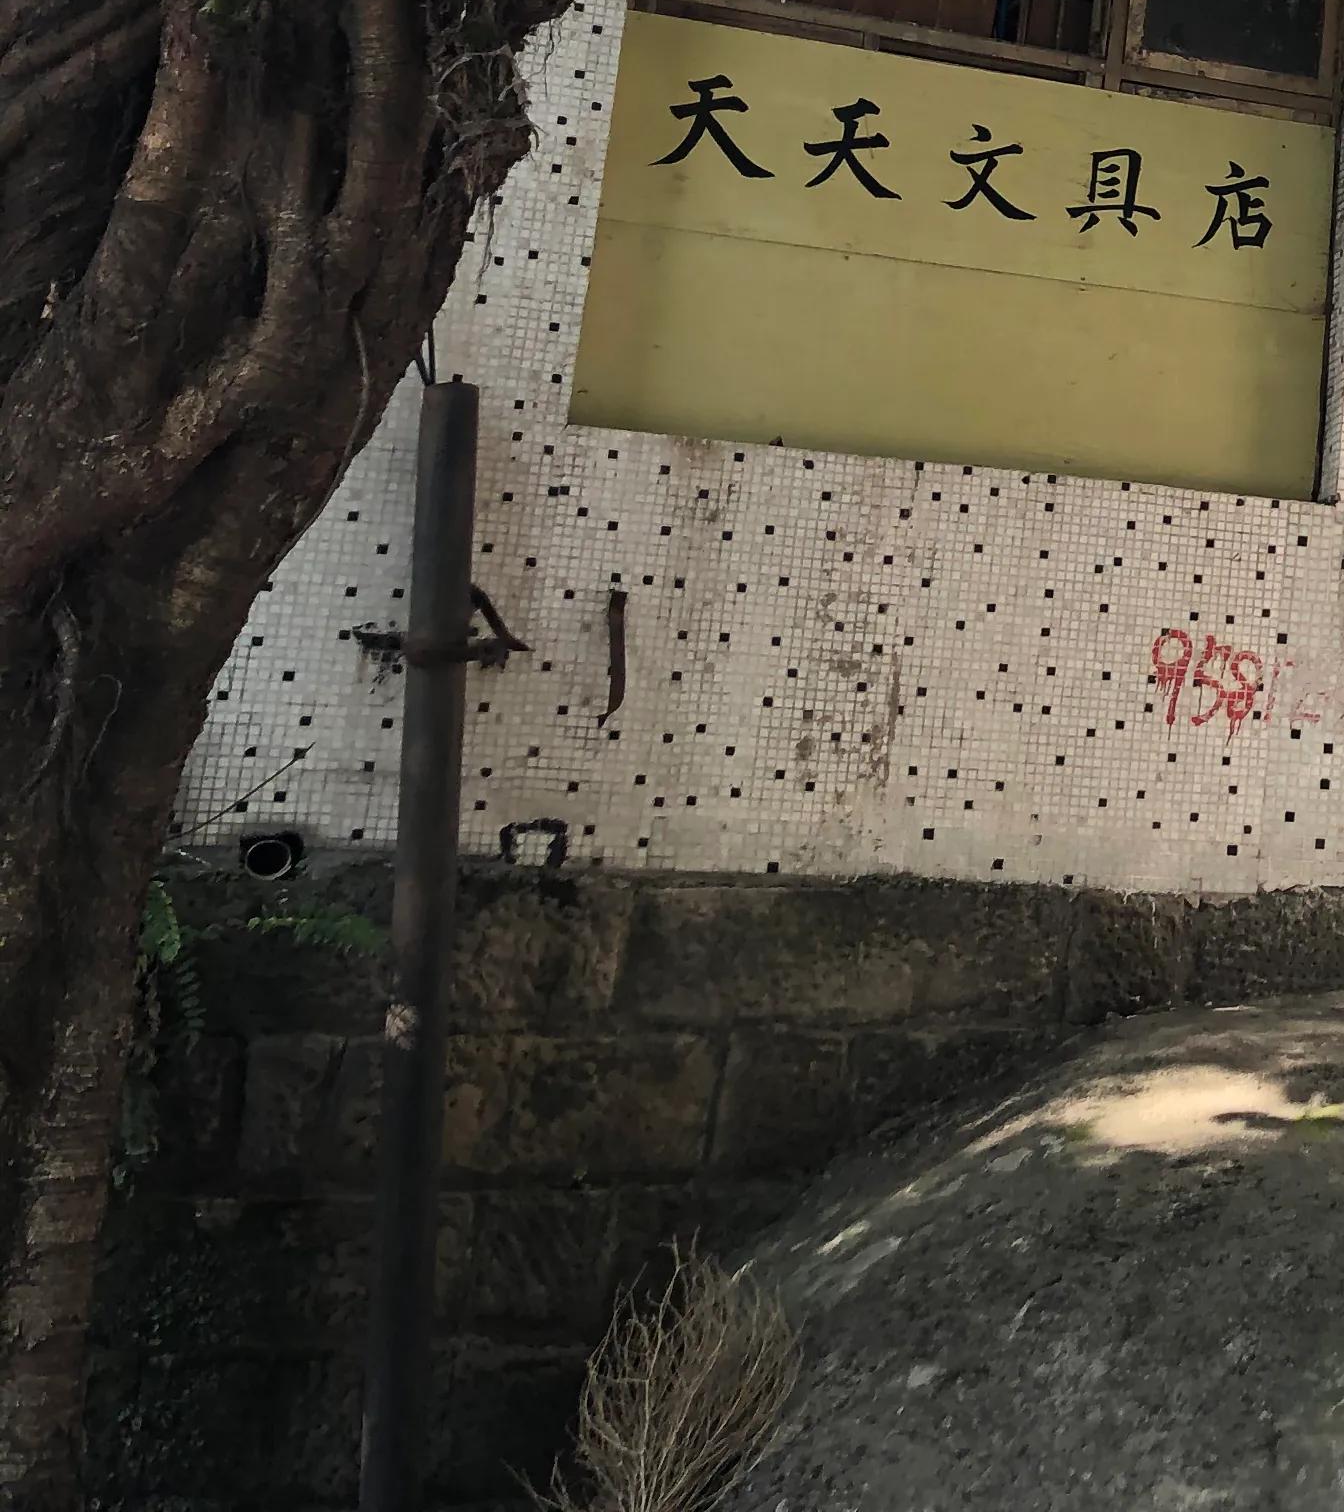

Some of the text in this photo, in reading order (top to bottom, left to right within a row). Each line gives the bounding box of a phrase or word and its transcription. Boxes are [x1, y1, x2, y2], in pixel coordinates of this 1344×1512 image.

[649, 74, 1273, 250] 天天文具店
